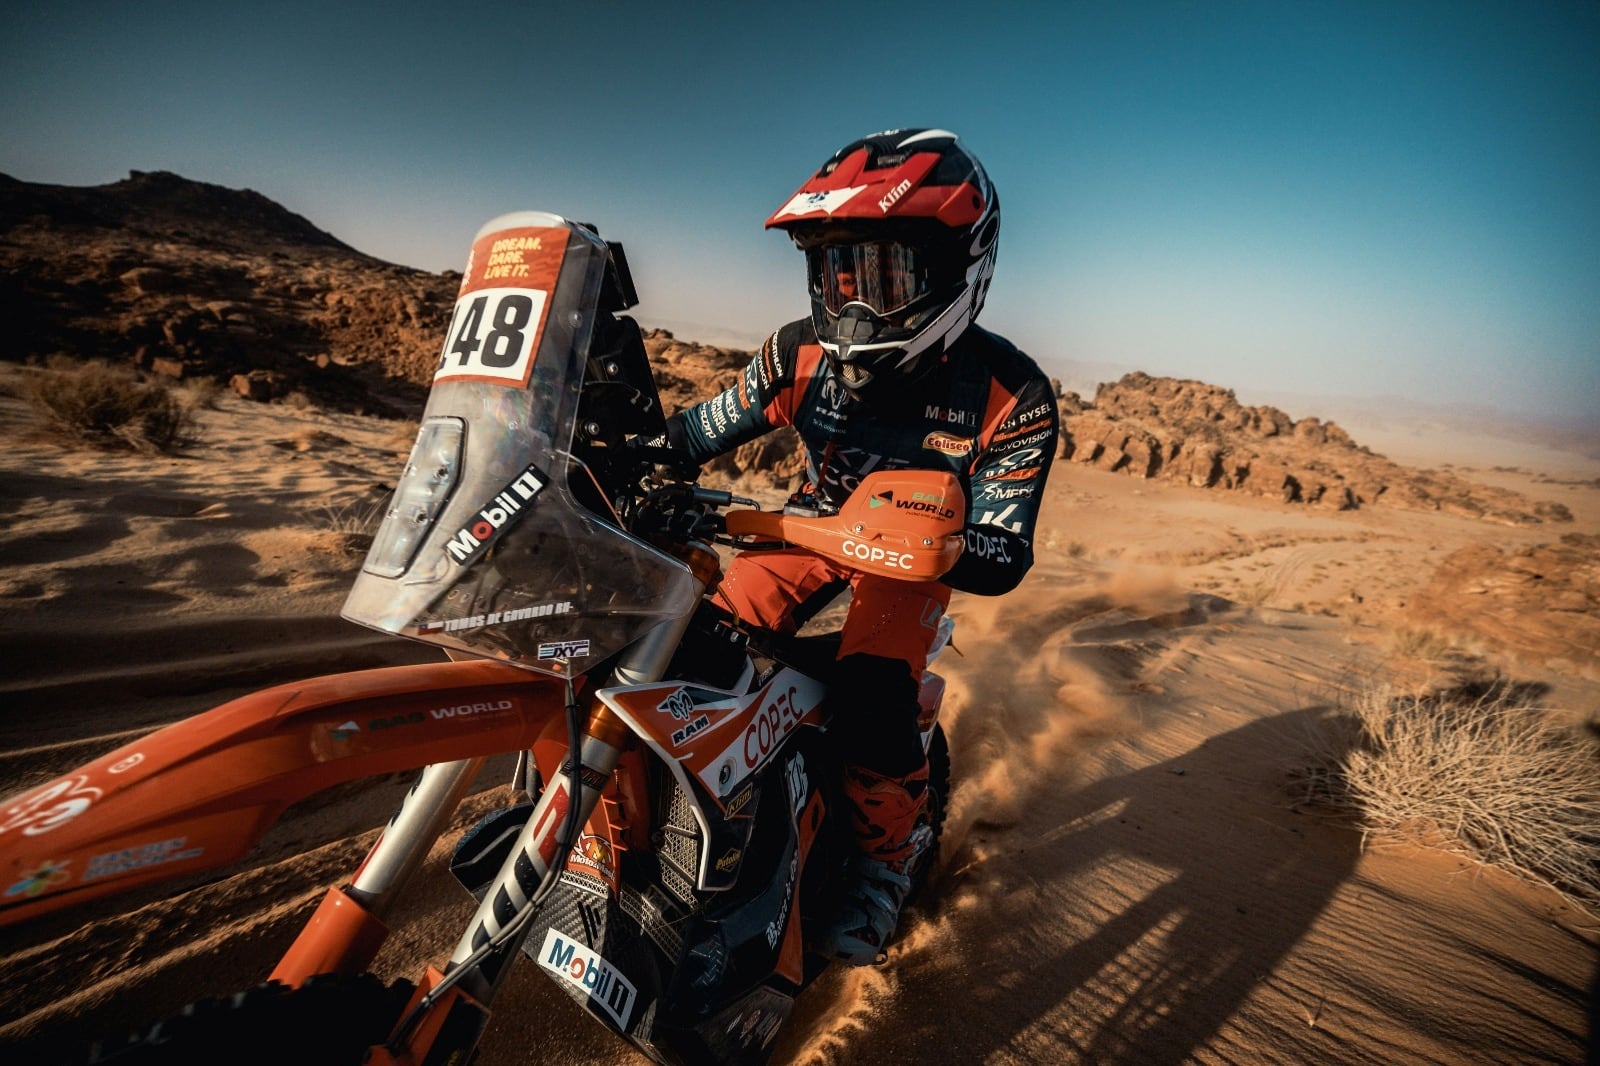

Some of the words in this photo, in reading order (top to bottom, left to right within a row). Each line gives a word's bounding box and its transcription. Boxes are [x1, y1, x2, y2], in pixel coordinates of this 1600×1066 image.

[488, 251, 524, 266] DARE.
[491, 237, 541, 252] DREAM.
[484, 265, 512, 279] LIVE
[511, 264, 529, 277] IT.
[439, 295, 533, 369] 48
[925, 400, 965, 425] Mobil
[996, 418, 1016, 432] AN
[1019, 403, 1052, 424] RYSEL
[896, 500, 955, 519] WORLD
[446, 491, 522, 560] Mobil
[842, 540, 914, 570] COPEC
[966, 529, 1012, 563] COPEC
[430, 700, 513, 720] WORLD
[672, 715, 709, 746] RAM
[743, 686, 804, 769] COPEC
[548, 938, 612, 1000] Mobil
